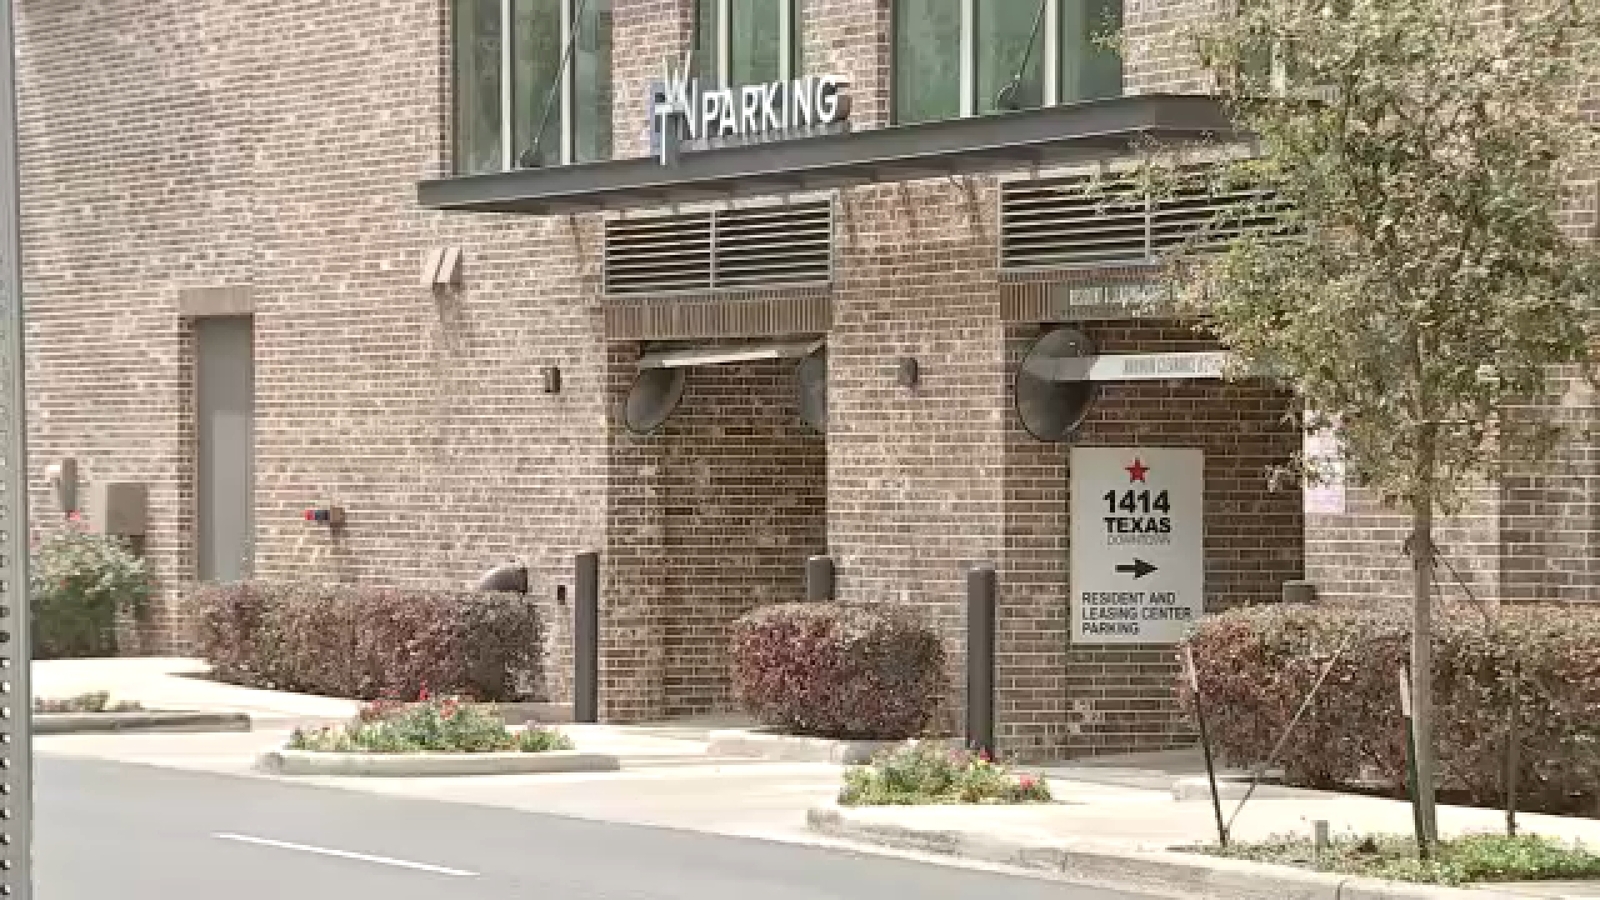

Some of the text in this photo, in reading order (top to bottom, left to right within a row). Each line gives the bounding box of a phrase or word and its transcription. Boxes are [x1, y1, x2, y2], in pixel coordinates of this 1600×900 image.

[702, 75, 838, 137] PARKING
[1102, 489, 1170, 514] 1414
[1103, 517, 1171, 533] TEXAS
[1082, 592, 1175, 605] RESIDENT AND
[1082, 607, 1192, 620] LEASING CENTER
[1082, 622, 1139, 635] PARKING
